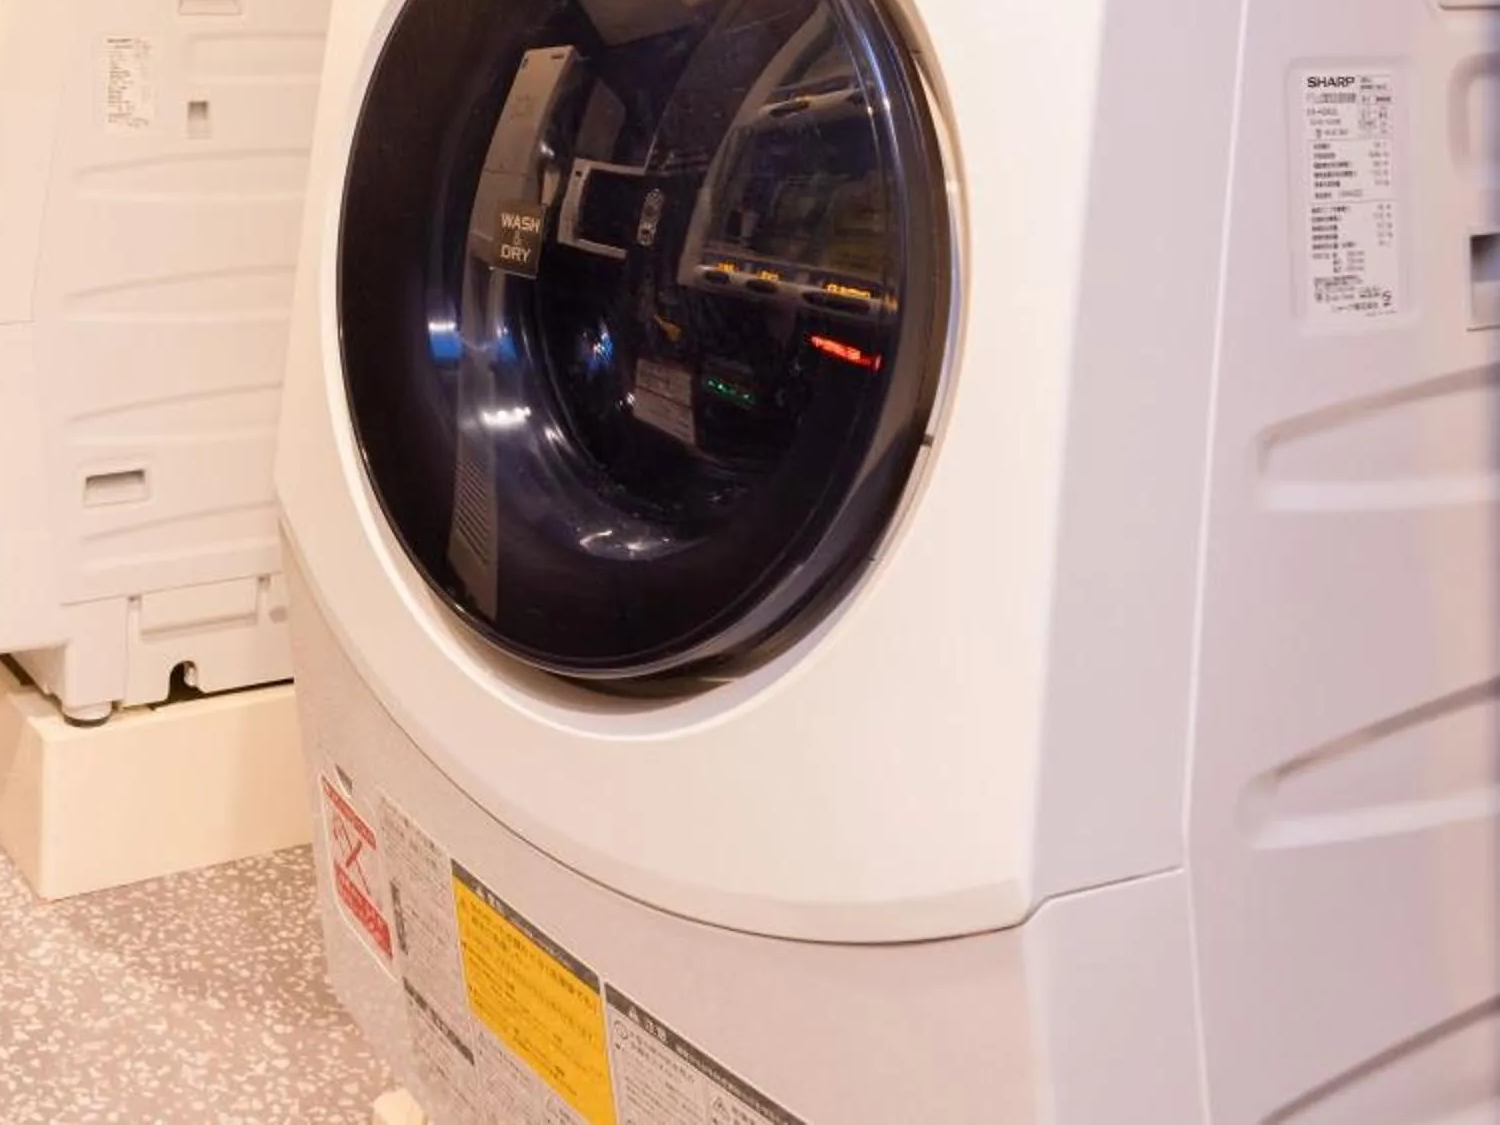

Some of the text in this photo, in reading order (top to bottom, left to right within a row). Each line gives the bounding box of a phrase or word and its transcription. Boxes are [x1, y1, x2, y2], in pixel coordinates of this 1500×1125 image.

[1307, 76, 1355, 88] SHARP
[501, 212, 540, 232] WASH
[500, 244, 531, 262] DRY
